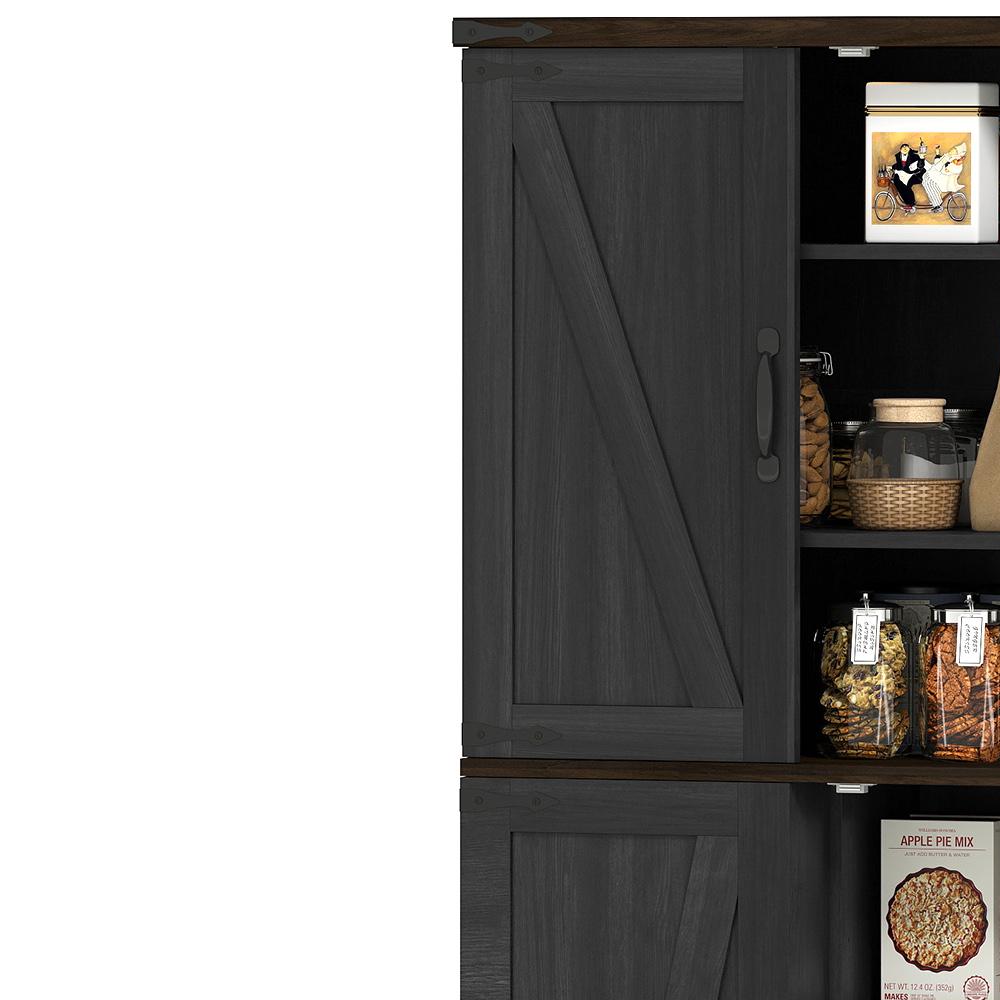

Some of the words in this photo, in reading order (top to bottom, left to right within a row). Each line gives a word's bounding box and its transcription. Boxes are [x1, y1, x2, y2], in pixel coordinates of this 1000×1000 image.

[900, 836, 932, 847] APPLE
[936, 836, 951, 847] PIE
[955, 836, 974, 848] MIX
